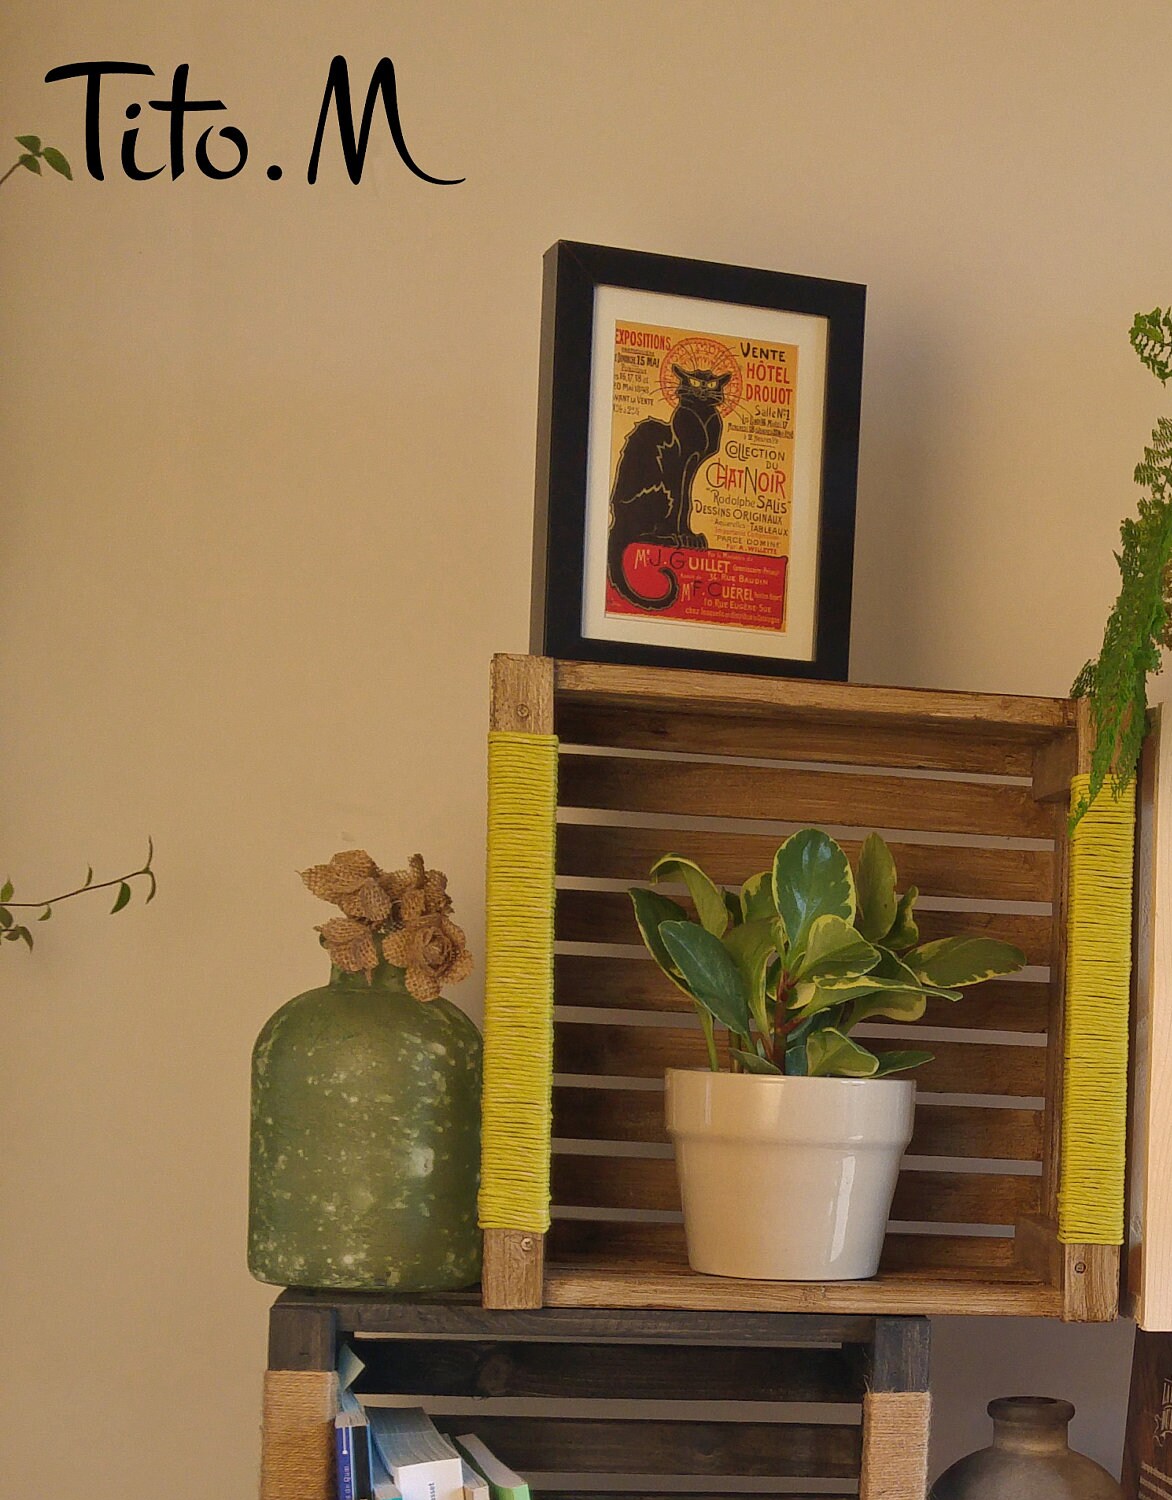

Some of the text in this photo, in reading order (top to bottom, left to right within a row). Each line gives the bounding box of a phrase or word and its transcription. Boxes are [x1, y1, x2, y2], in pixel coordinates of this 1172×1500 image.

[740, 342, 785, 362] VENTE
[746, 361, 790, 384] HÔTEL
[746, 384, 793, 405] DROUOT
[725, 440, 785, 461] COLLECTION
[766, 461, 778, 470] DU
[694, 500, 783, 525] DESSINS ORIGINAUX
[716, 535, 743, 545] PARCE
[750, 523, 789, 536] TABLEAUX
[669, 551, 731, 574] GUILLET
